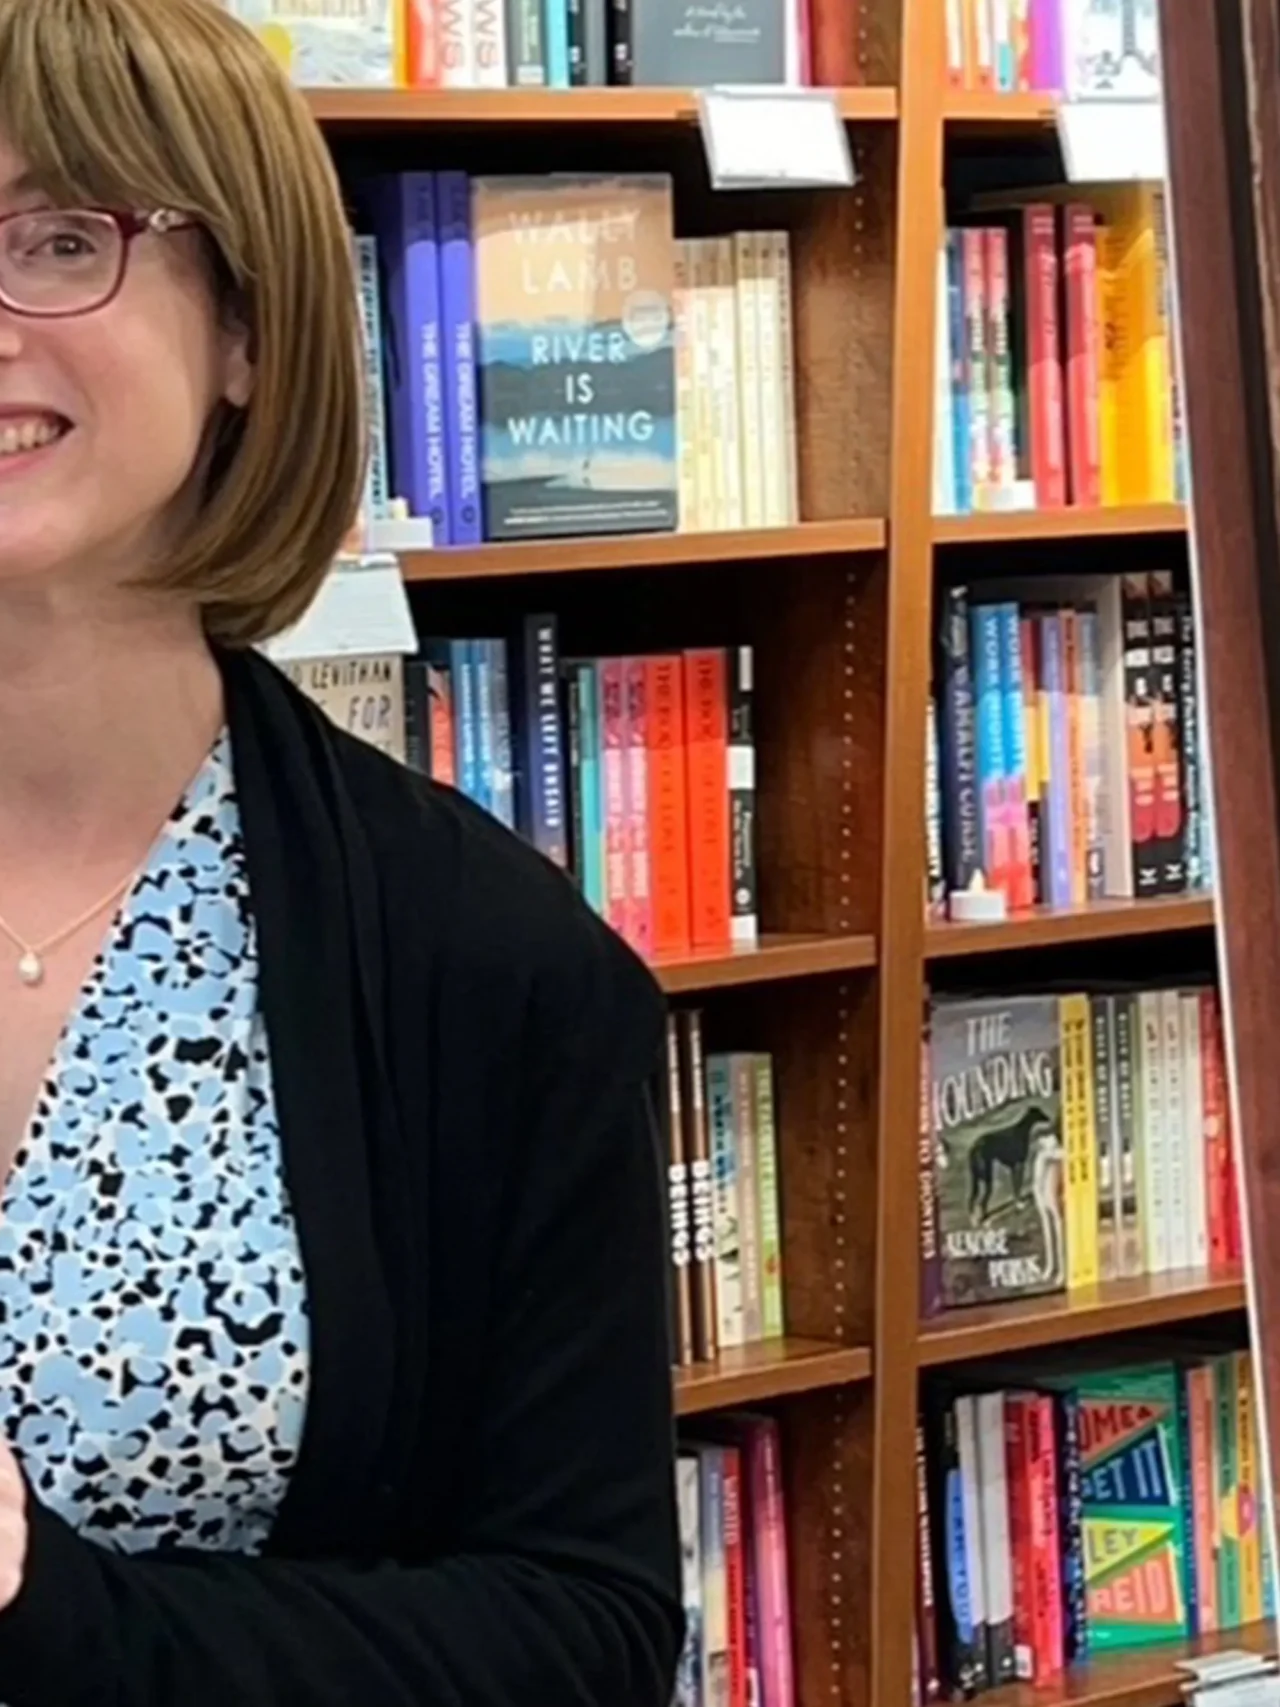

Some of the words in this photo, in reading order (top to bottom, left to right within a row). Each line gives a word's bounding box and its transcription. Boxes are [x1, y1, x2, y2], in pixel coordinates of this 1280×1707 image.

[509, 209, 642, 246] WALLY
[522, 257, 638, 295] LAMB
[422, 322, 439, 357] THE
[455, 322, 472, 357] THE
[531, 334, 626, 364] RIVER
[424, 363, 441, 433] DREAM
[457, 362, 474, 432] DREAM
[566, 375, 594, 404] IS
[508, 412, 654, 446] WAITING
[427, 438, 443, 499] HOTEL
[460, 437, 476, 499] HOTEL
[536, 627, 556, 674] WHAT
[985, 618, 1000, 686] WORK
[311, 661, 391, 689] LEVITHAN
[540, 682, 554, 707] WE
[348, 694, 391, 731] FOR
[541, 714, 557, 756] LEFT
[1182, 697, 1196, 753] Pickers
[542, 763, 561, 827] UNSAID
[966, 1012, 1013, 1056] THE
[668, 1163, 692, 1268] BEINGS
[691, 1160, 713, 1263] BEINGS
[1131, 1439, 1161, 1498] IT
[1094, 1559, 1167, 1615] REID
